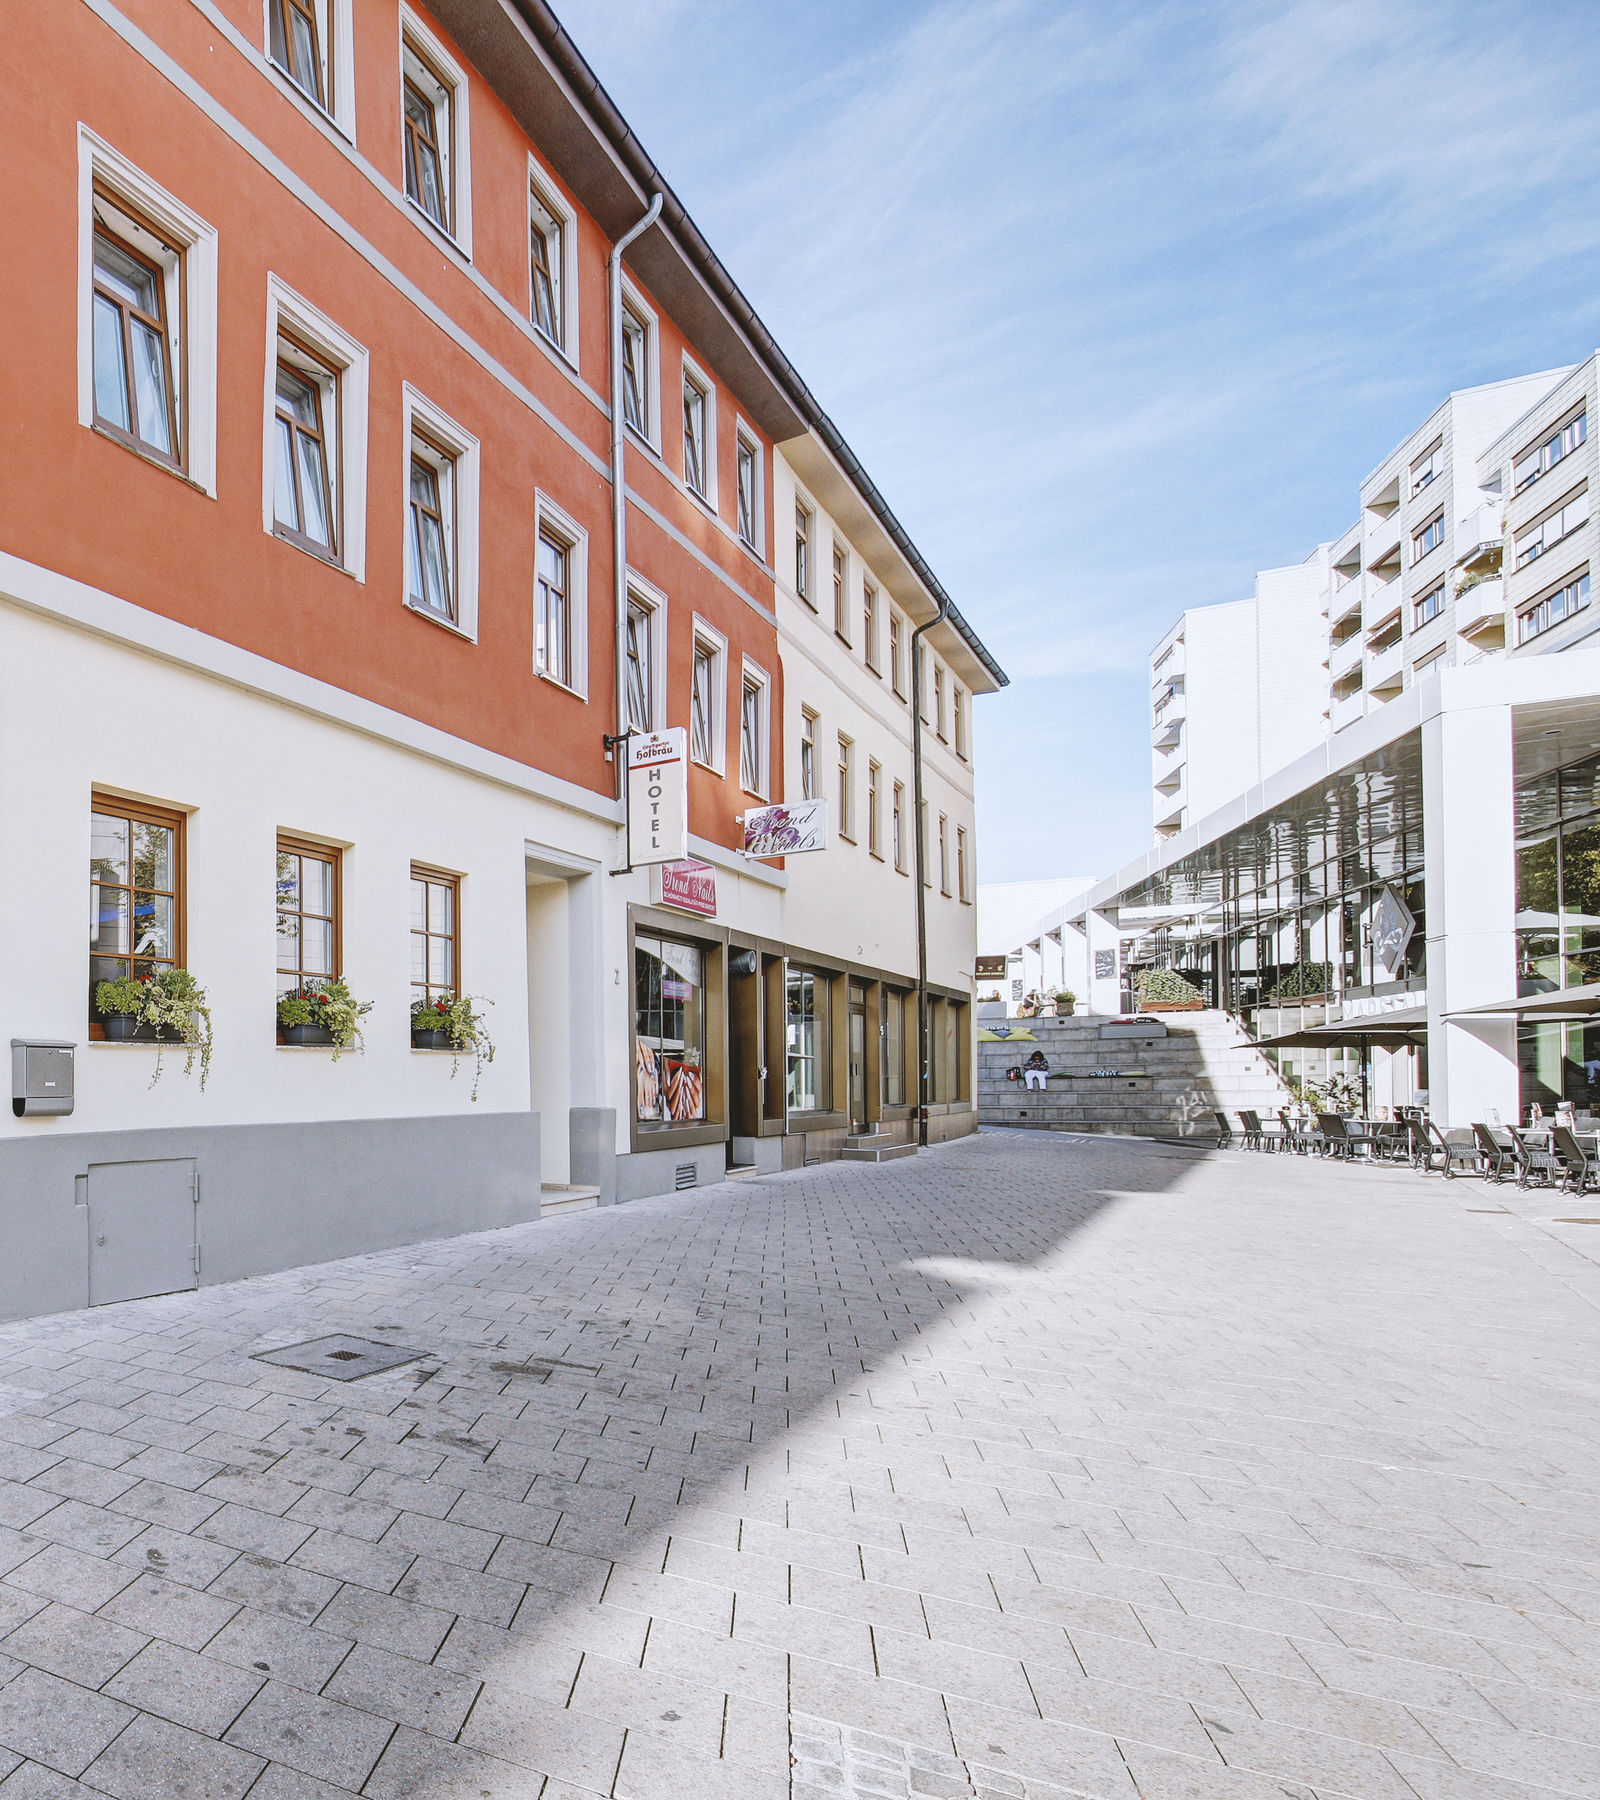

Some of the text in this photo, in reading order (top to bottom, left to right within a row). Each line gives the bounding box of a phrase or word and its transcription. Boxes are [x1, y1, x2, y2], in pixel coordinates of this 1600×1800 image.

[636, 746, 673, 761] Hofbräu
[647, 768, 663, 849] HOTEL
[748, 806, 817, 834] Trend
[752, 827, 818, 854] Nails
[663, 864, 715, 903] Trend Nails
